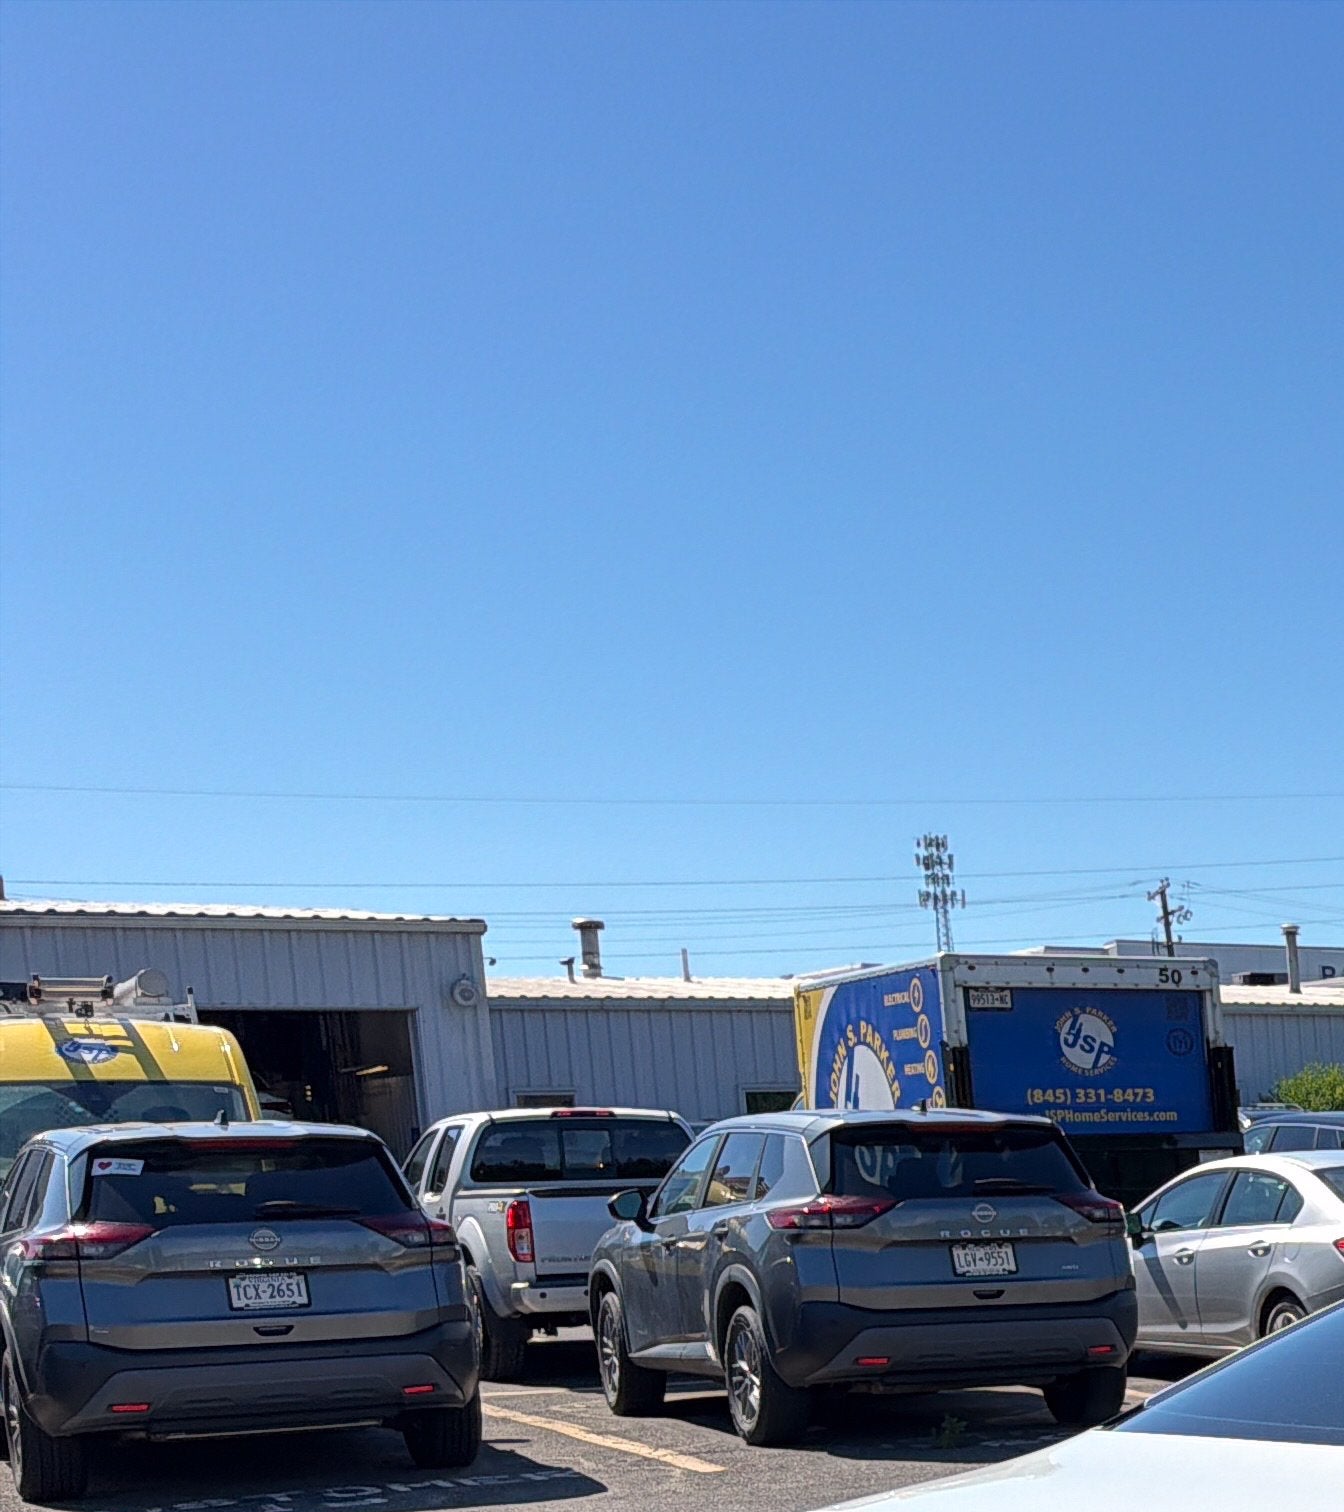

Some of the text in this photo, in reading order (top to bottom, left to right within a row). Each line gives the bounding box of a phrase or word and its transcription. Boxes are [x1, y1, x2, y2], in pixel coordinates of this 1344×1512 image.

[1158, 968, 1182, 985] 50
[859, 1020, 901, 1105] PARKER
[1027, 1088, 1155, 1105] (845) 331-8473
[233, 1282, 303, 1302] TCX-2651
